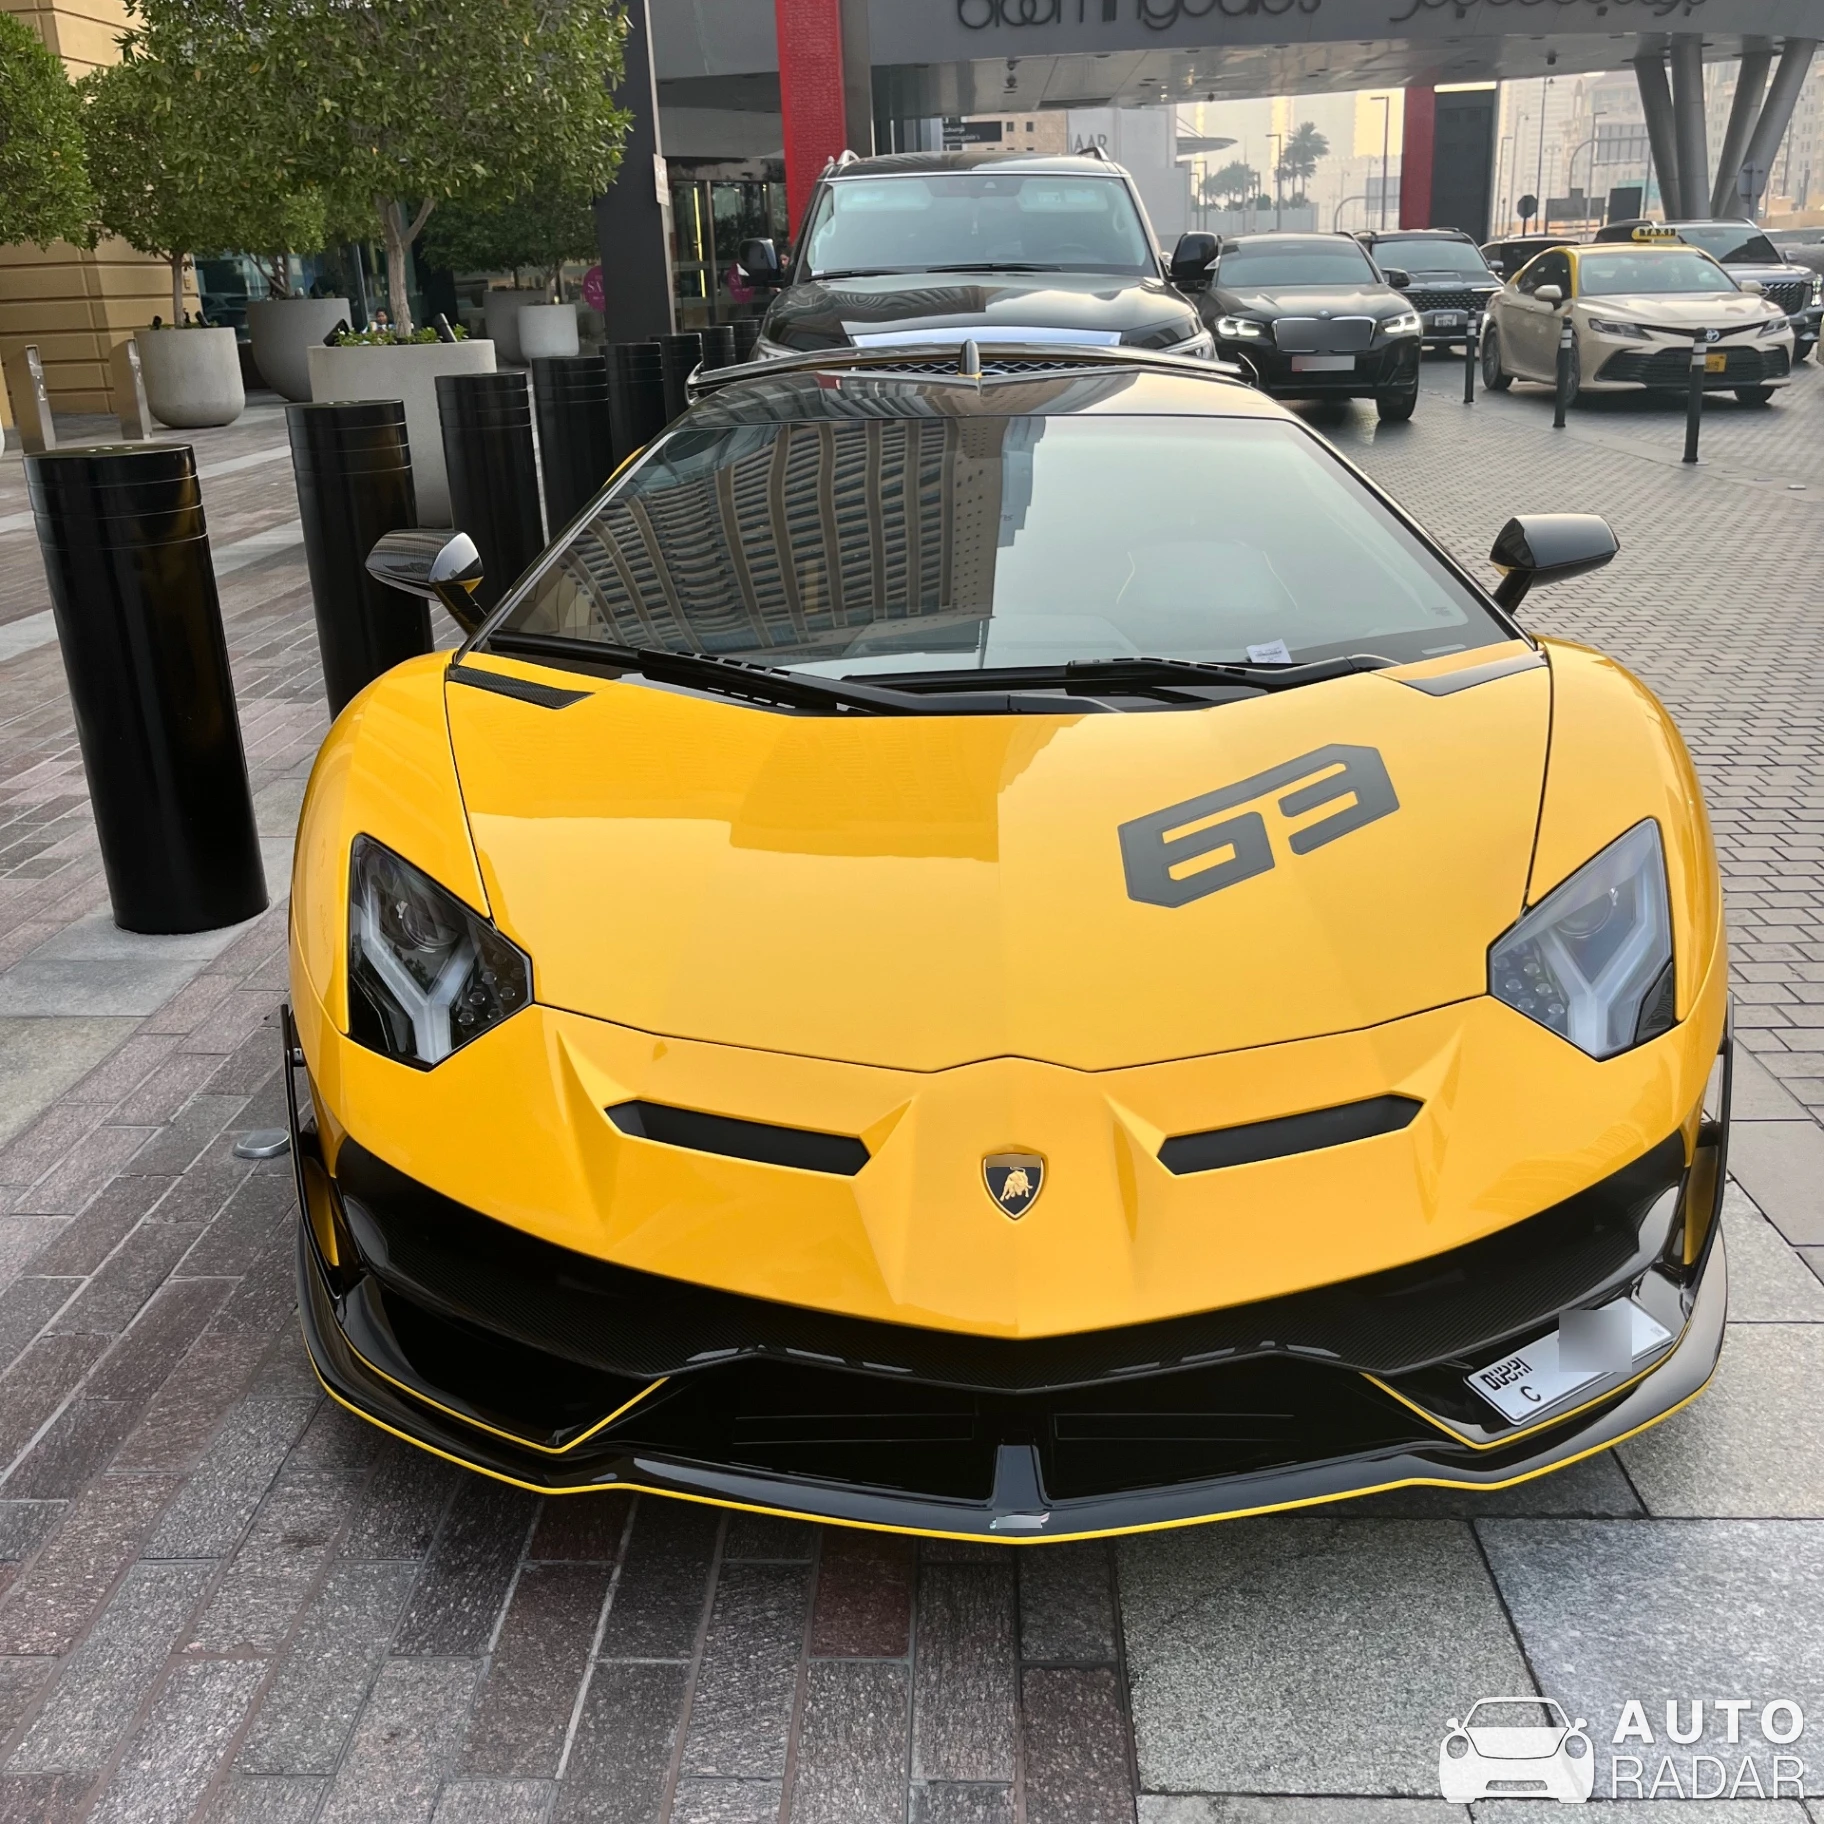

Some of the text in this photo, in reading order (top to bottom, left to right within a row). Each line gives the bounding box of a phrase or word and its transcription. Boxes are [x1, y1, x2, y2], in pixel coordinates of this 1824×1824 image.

[1641, 228, 1675, 236] TAXI
[1117, 743, 1400, 908] 63
[1520, 1386, 1542, 1402] C
